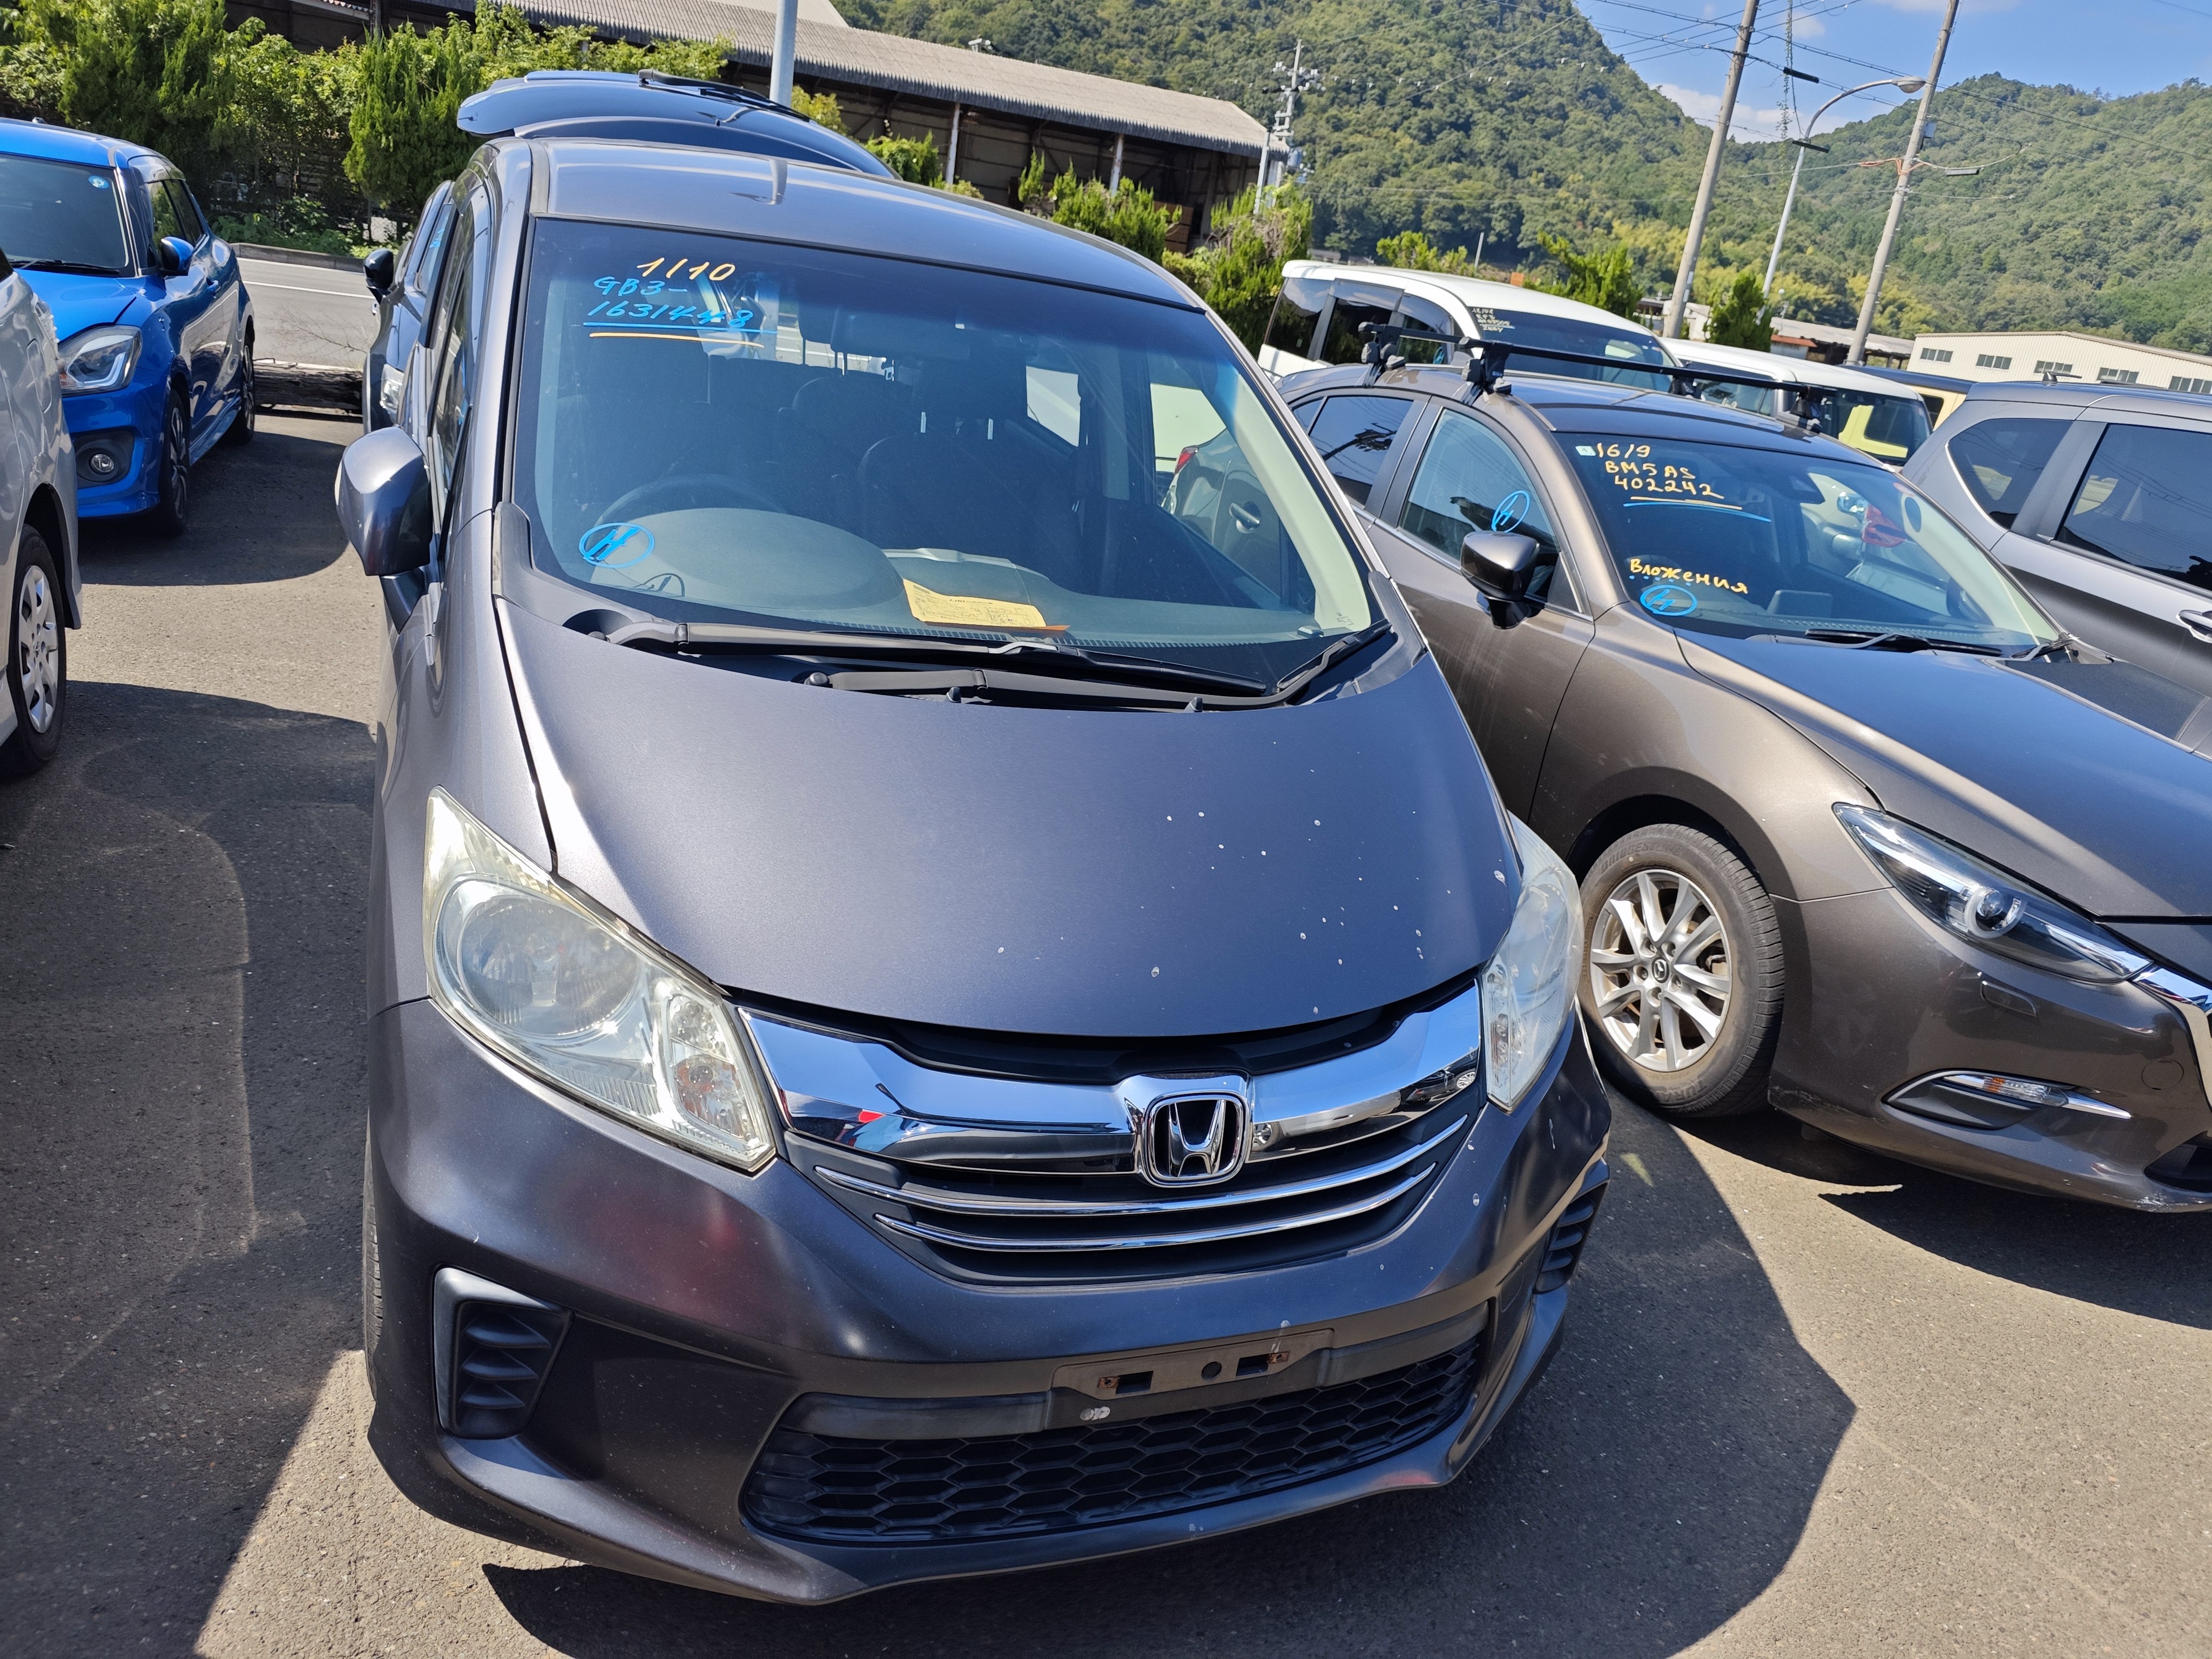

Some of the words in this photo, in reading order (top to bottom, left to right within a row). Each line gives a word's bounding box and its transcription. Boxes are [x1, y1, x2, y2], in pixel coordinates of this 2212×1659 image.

[636, 257, 736, 281] 1/10
[587, 300, 754, 328] 1631448
[1597, 442, 1651, 458] 16/9
[1614, 475, 1725, 500] 402242
[1630, 558, 1749, 595] Вложения
